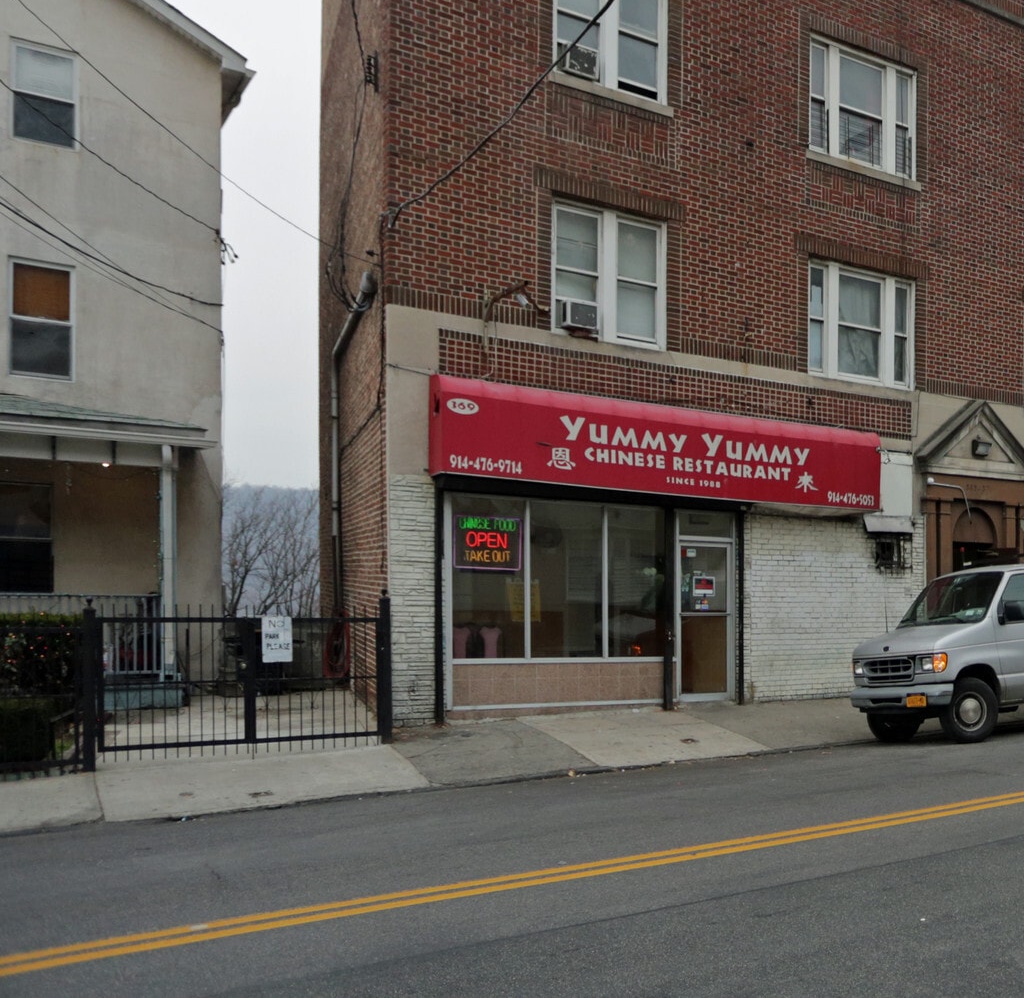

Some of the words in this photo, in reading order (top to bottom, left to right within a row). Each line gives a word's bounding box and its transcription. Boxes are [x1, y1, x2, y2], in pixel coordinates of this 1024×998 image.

[450, 400, 475, 411] 369
[559, 415, 688, 453] YUMMY
[701, 433, 810, 466] YUMMY
[449, 454, 522, 474] 914-476-9714
[584, 447, 666, 469] CHINESE
[673, 456, 791, 481] RESTAURANT
[666, 476, 695, 486] SINCE
[699, 480, 721, 488] 1988
[827, 491, 875, 506] 914-476-5053
[494, 518, 516, 531] FOOD
[465, 530, 508, 549] OPEN
[464, 550, 490, 562] TAKE
[492, 550, 511, 562] OUT
[268, 619, 285, 628] NO
